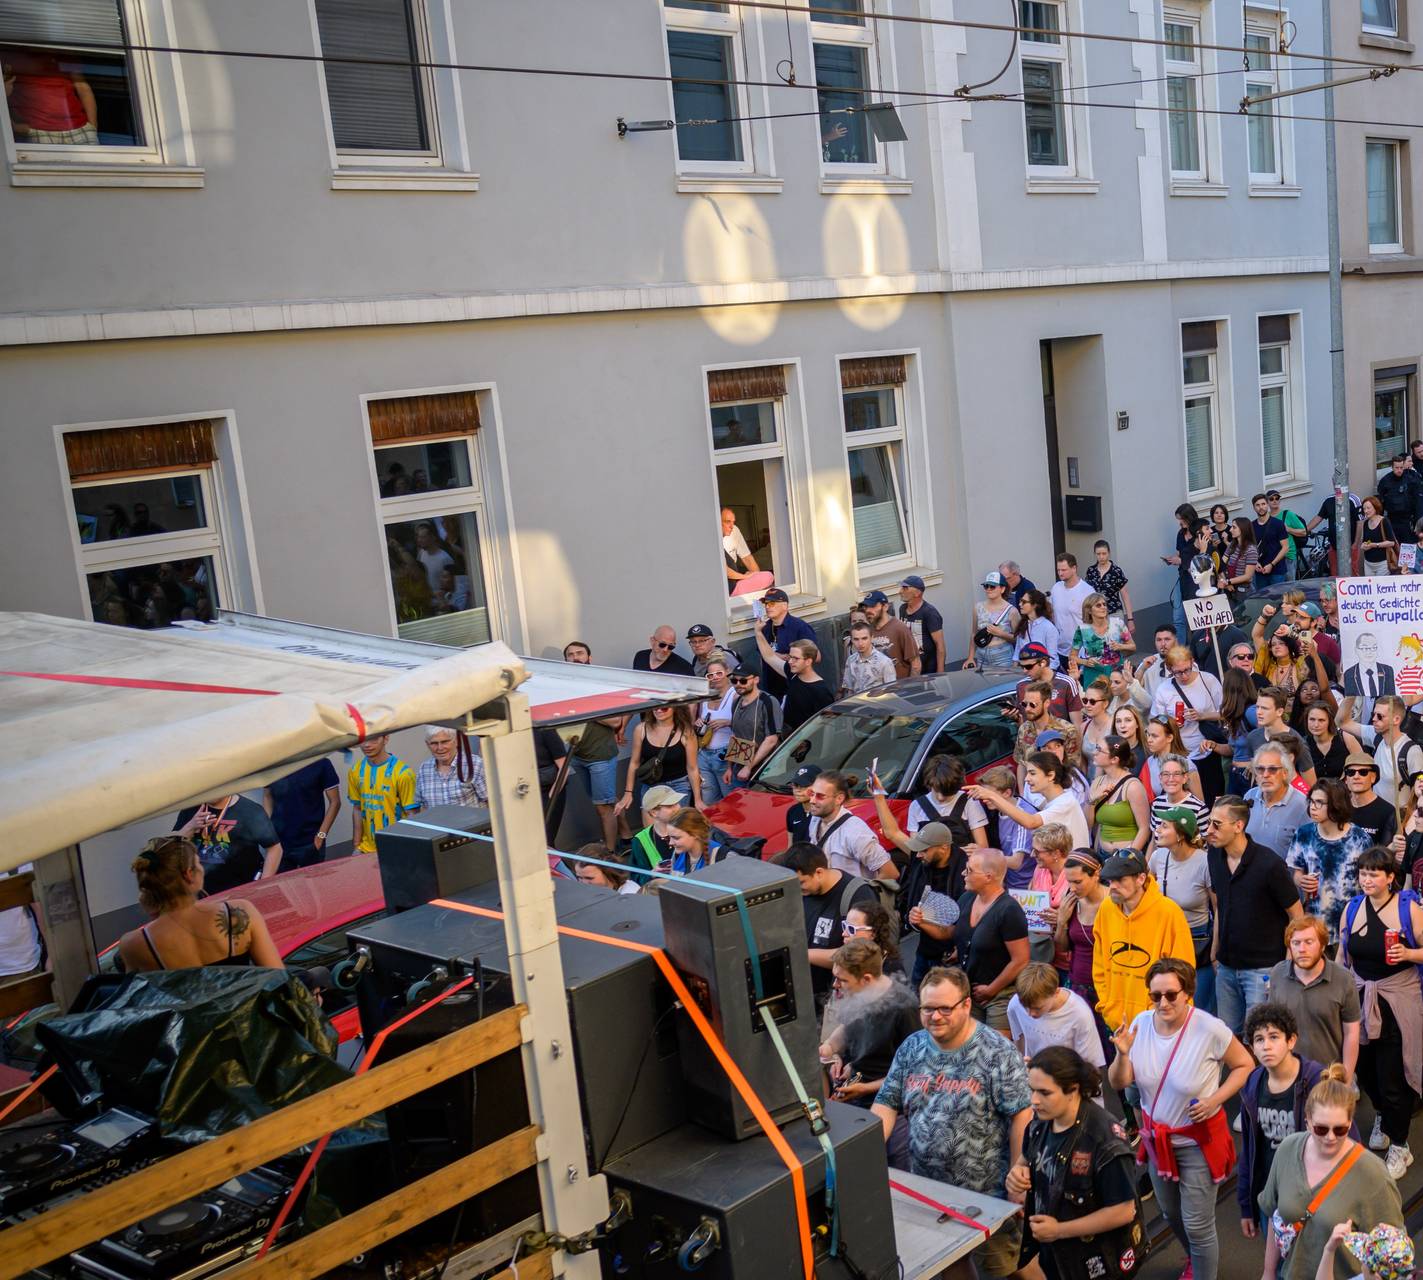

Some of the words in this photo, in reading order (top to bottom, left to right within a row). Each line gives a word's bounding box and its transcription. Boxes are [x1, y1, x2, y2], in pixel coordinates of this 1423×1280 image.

[1338, 579, 1372, 596] Conni
[1376, 582, 1398, 595] kennt
[1400, 580, 1422, 593] mehr
[1194, 600, 1214, 614] NO
[1340, 599, 1375, 610] deutsche
[1379, 596, 1420, 609] Gedichte
[1192, 614, 1214, 629] NAZI
[1215, 610, 1233, 625] AFD
[1342, 613, 1358, 624] als
[50, 1165, 103, 1190] Pioneer
[105, 1158, 121, 1169] DJ
[201, 1226, 253, 1254] Pioneer
[256, 1218, 271, 1228] DJ
